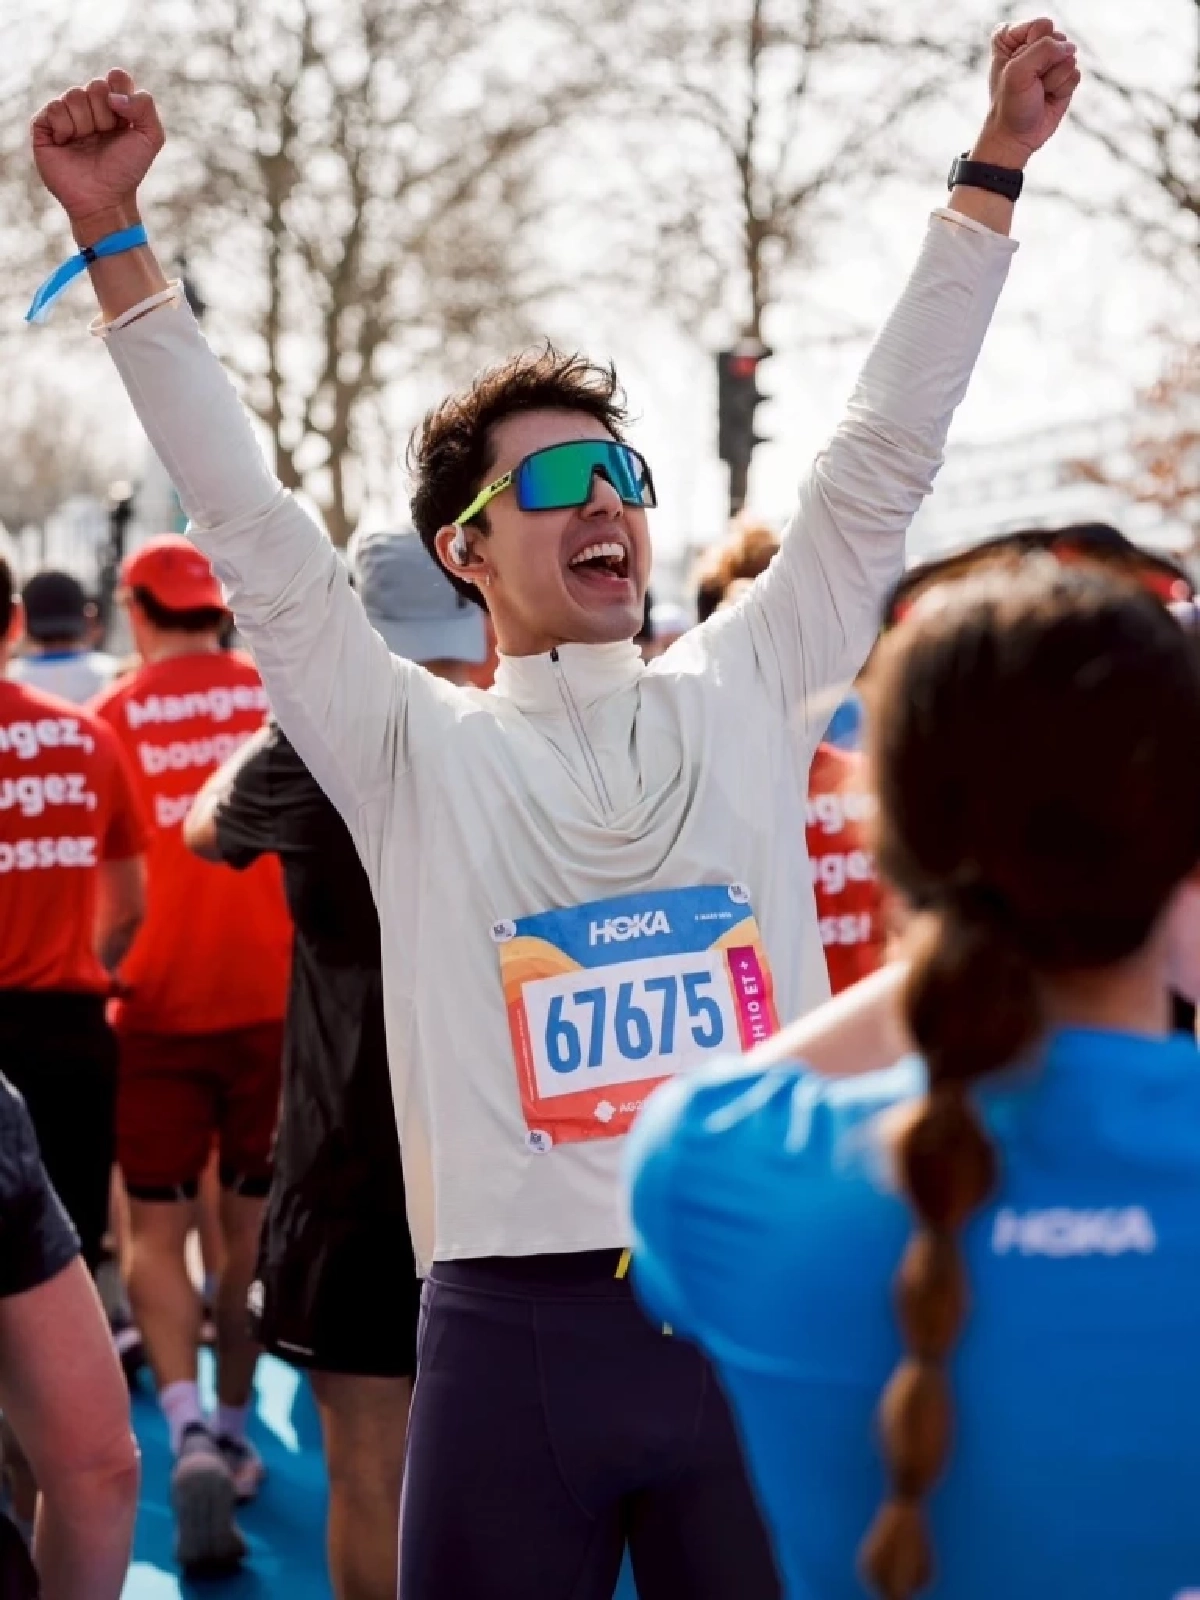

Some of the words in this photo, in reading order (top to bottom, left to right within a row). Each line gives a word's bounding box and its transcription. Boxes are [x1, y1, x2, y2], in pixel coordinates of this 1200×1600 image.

[589, 909, 671, 946] HOKA
[545, 971, 724, 1073] 67675
[992, 1206, 1156, 1258] HOKA
